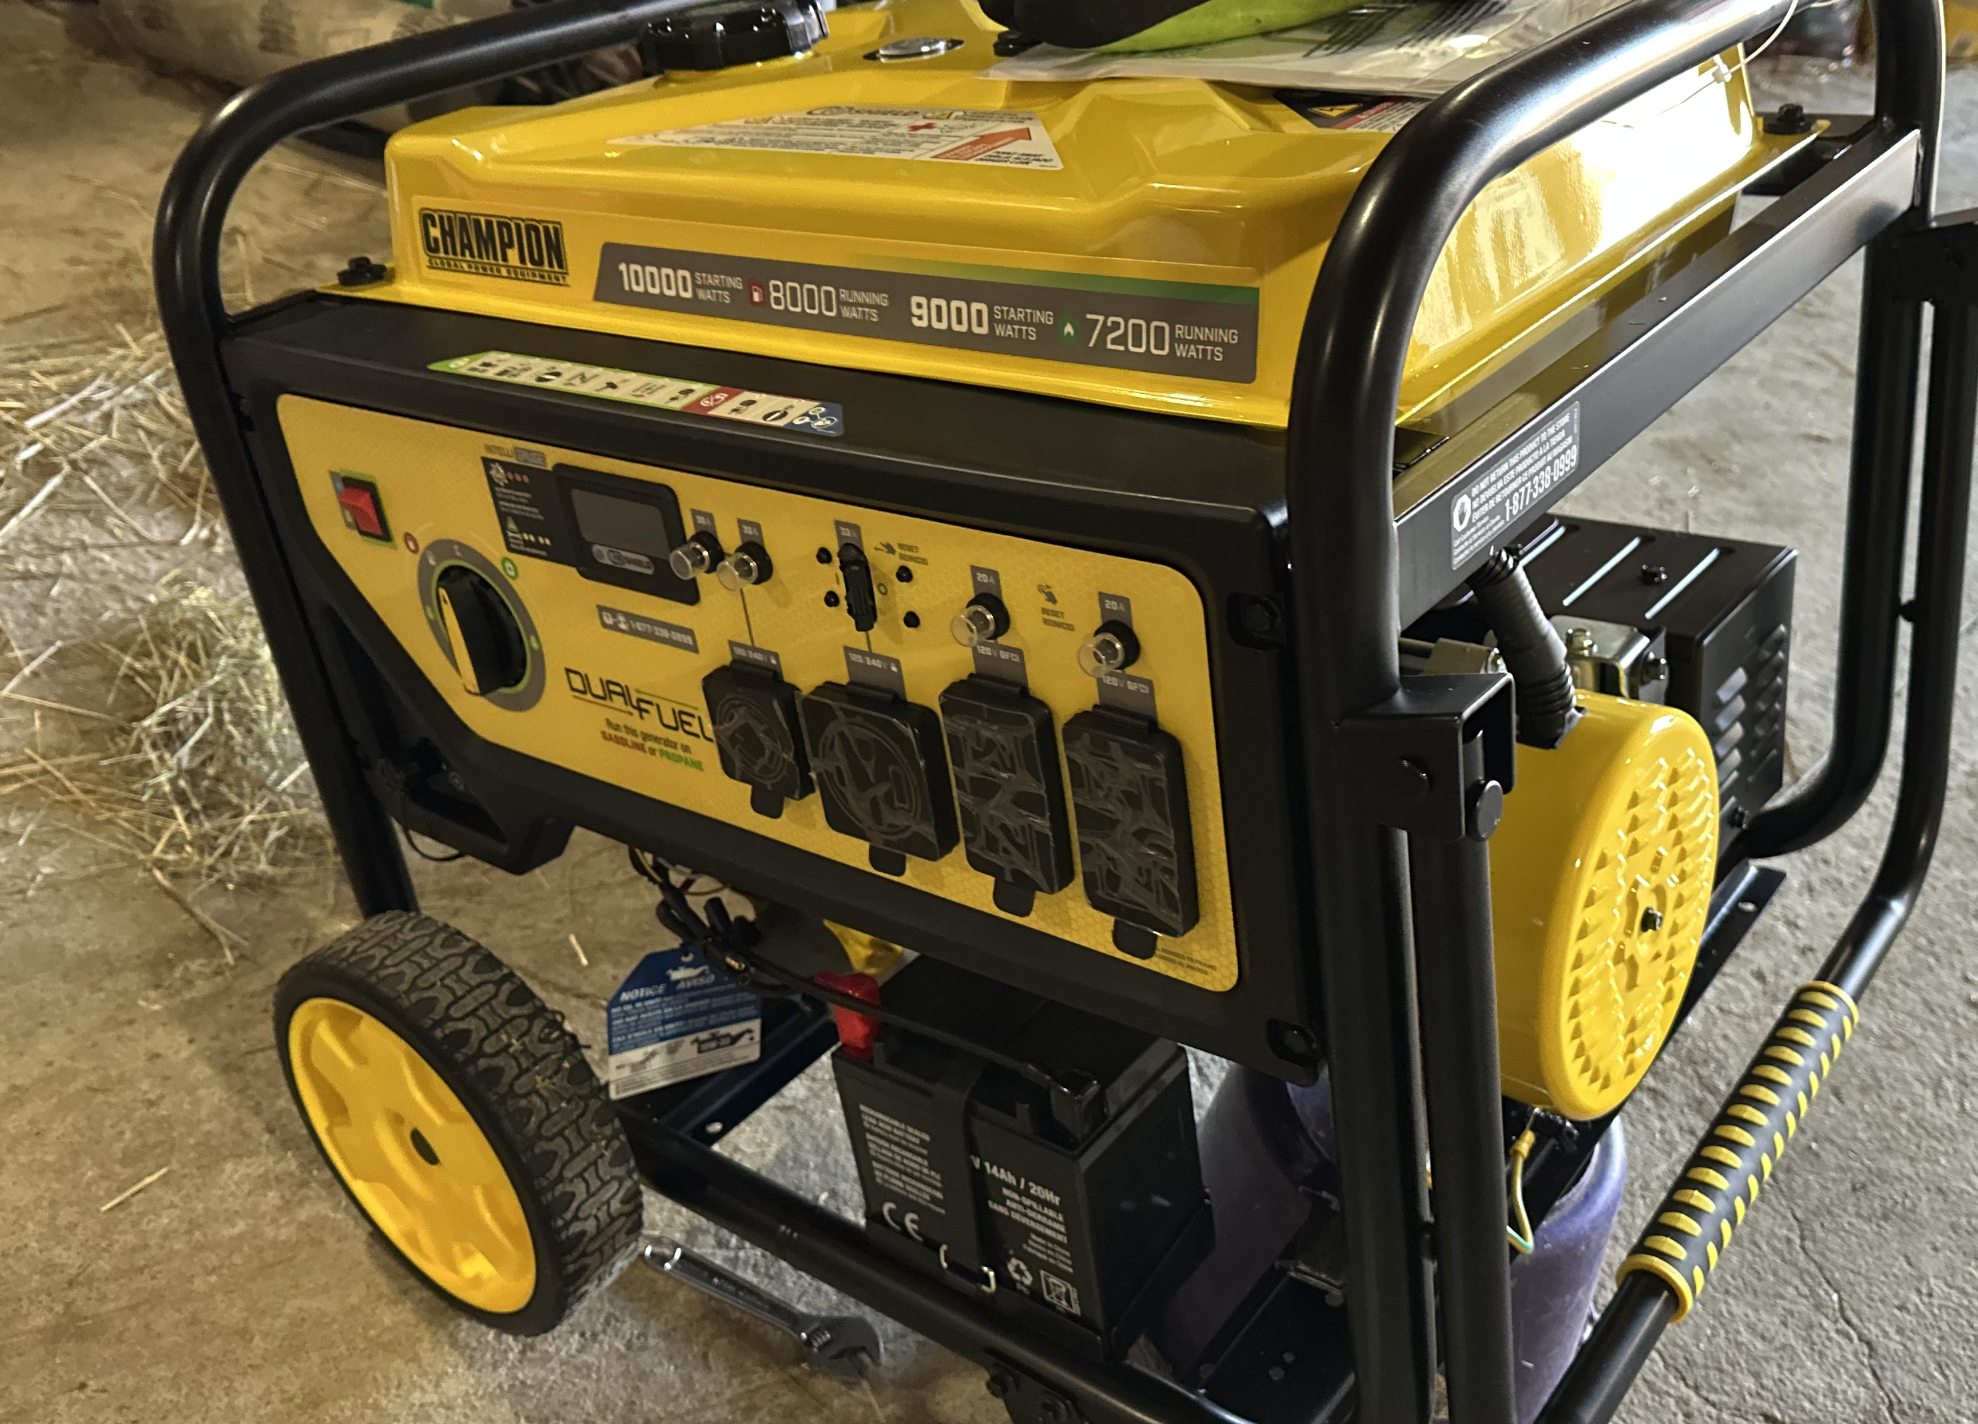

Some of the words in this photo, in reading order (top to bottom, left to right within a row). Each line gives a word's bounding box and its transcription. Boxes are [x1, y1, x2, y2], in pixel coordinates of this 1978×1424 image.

[420, 208, 567, 272] CHAMPION
[428, 257, 465, 270] GLOBAL
[467, 263, 503, 275] POWER
[506, 267, 567, 285] EQUIPMENT
[618, 262, 693, 299] 10000
[694, 272, 743, 290] STARTING
[696, 288, 731, 304] WATTS
[769, 279, 836, 317] 8000
[839, 288, 889, 308] RUNNING
[840, 305, 879, 322] WATTS
[910, 296, 989, 335] 9000
[993, 305, 1054, 326] STARTING
[994, 322, 1036, 341] WATTS
[1086, 313, 1170, 356] 7200
[1174, 324, 1239, 345] RUNNING
[1175, 342, 1224, 362] WATTS
[1505, 445, 1577, 522] 1-877-338-0999
[976, 572, 995, 584] 20A
[1104, 600, 1125, 612] 20A
[620, 983, 667, 1002] NOTICE
[984, 1161, 1017, 1187] 14Ah
[1028, 1181, 1061, 1206] 20Hr
